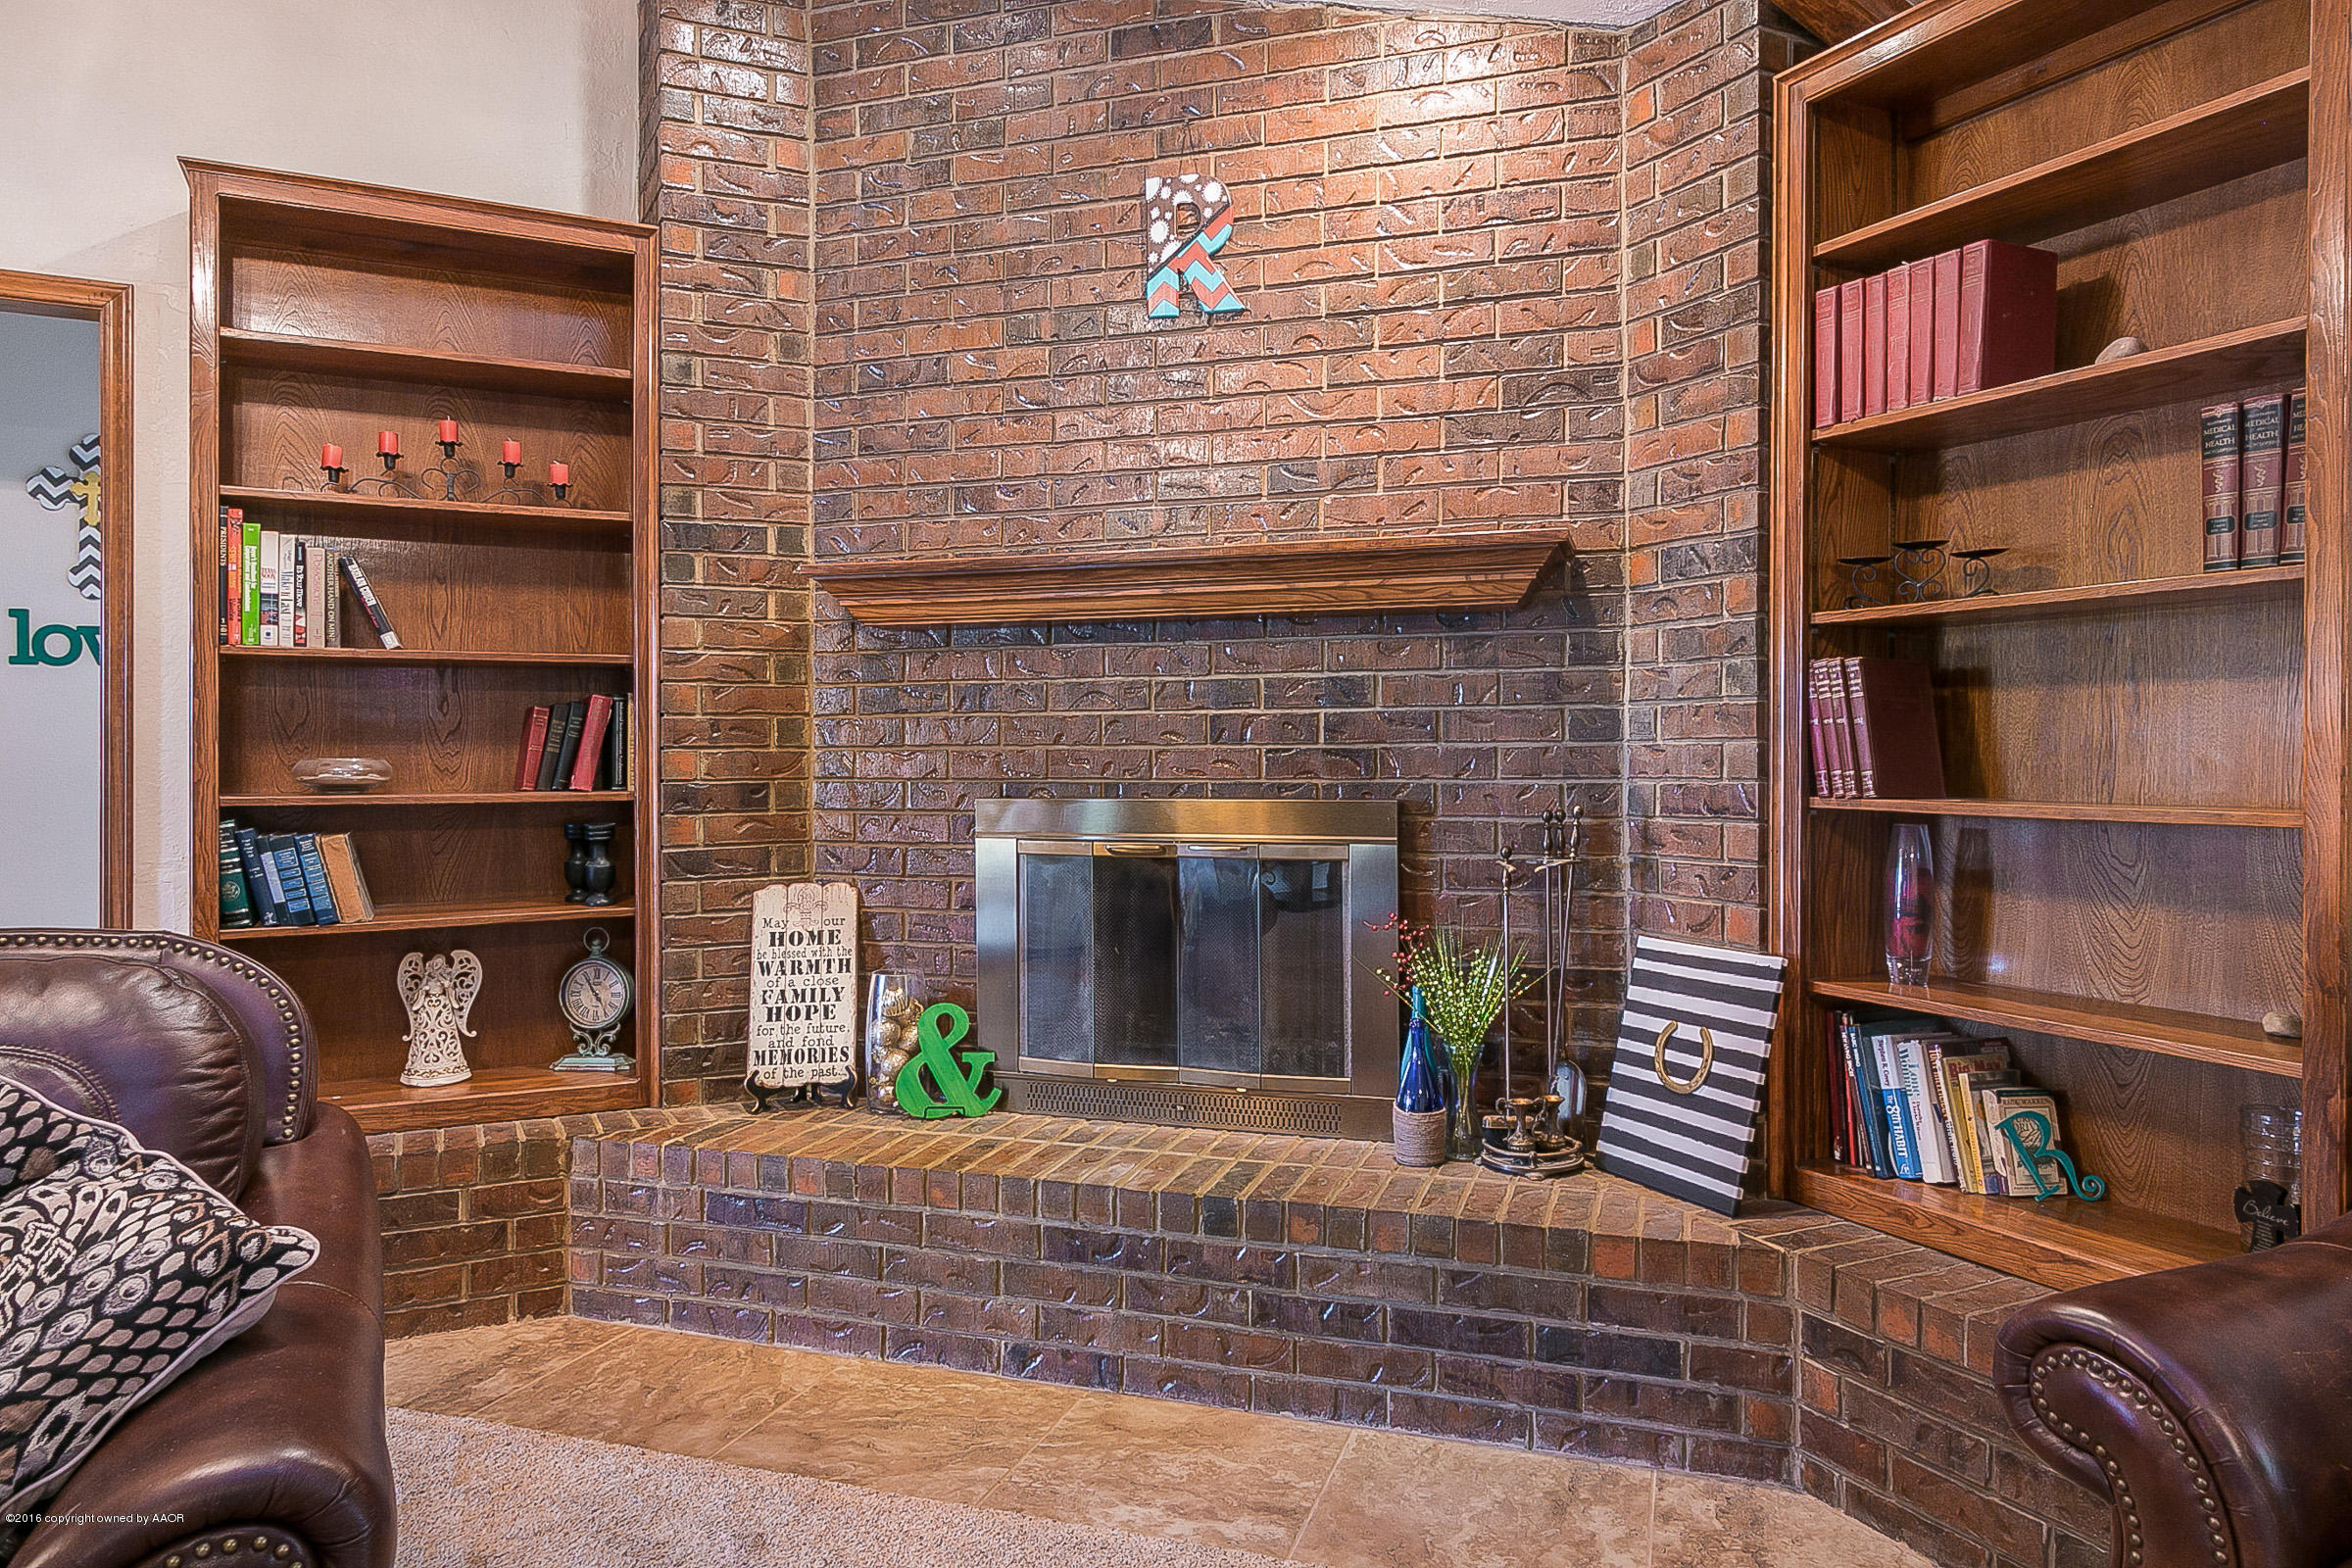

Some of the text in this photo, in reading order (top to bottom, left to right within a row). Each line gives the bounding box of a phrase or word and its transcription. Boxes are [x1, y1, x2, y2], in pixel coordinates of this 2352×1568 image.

[2205, 437, 2235, 449] HEALTH
[2244, 430, 2279, 441] HEALTH
[327, 612, 335, 622] ON
[762, 917, 846, 929] May our
[768, 929, 841, 947] HOME
[757, 946, 853, 960] be blessed with the
[758, 958, 852, 976] WARMTH
[766, 976, 839, 988] of a close
[760, 986, 845, 1005] FAMILY
[765, 1004, 836, 1023] HOPE
[757, 1025, 775, 1037] for
[780, 1024, 801, 1035] the
[768, 1035, 835, 1049] and fond
[753, 1046, 850, 1066] MEMORIES
[896, 1003, 1002, 1118] &
[762, 1068, 777, 1079] of
[782, 1067, 804, 1078] the
[1898, 1049, 1913, 1097] Woman
[1886, 1104, 1901, 1123] 8th
[1893, 1125, 1909, 1158] HABIT
